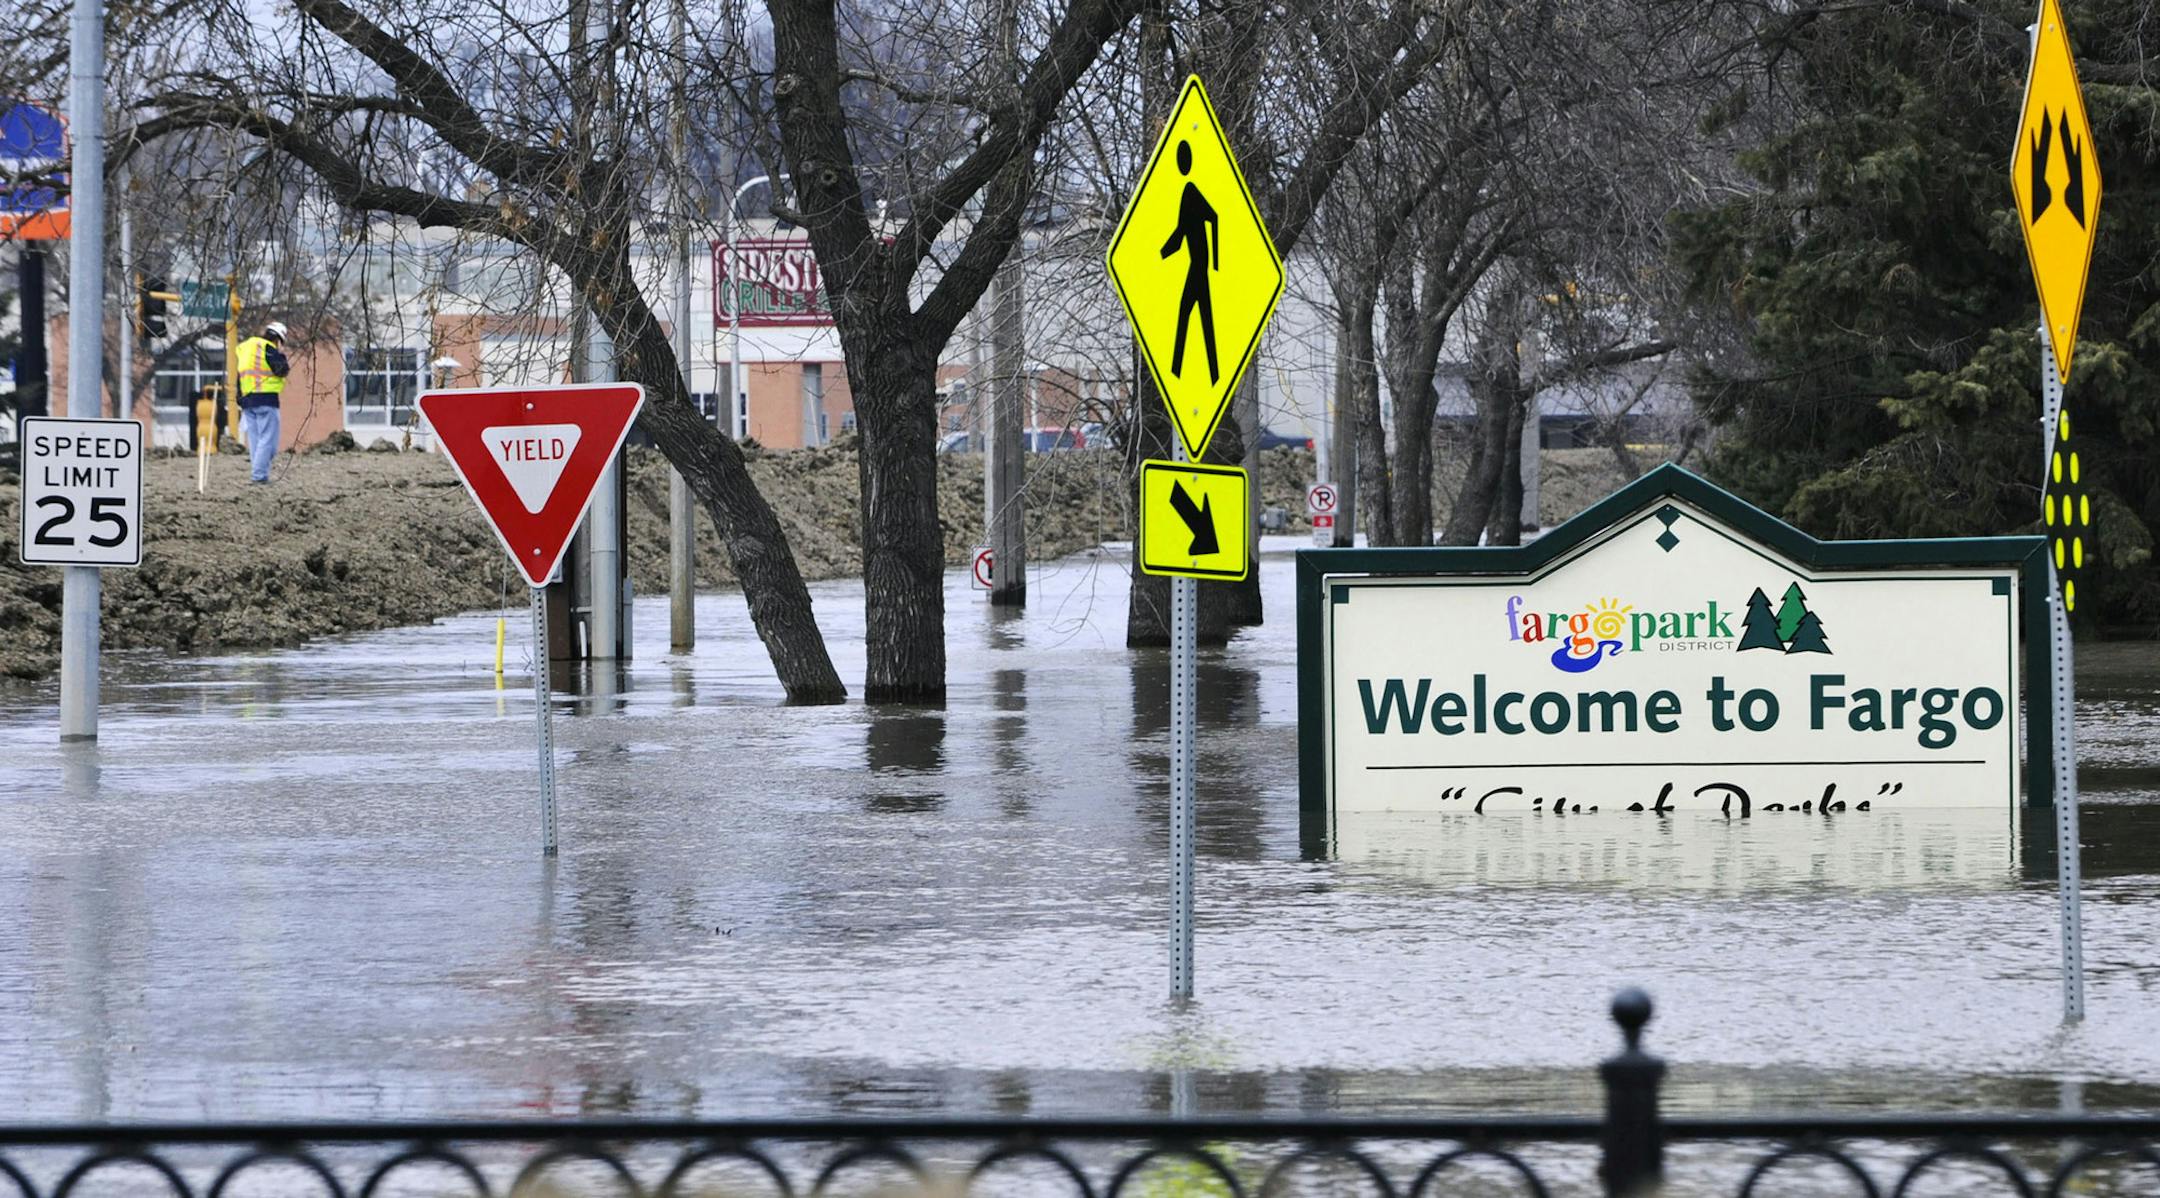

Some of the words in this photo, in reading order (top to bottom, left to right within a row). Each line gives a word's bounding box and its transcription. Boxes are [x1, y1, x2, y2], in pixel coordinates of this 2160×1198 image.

[34, 436, 131, 458] SPEED
[500, 438, 564, 461] YIELD
[45, 466, 119, 488] LIMIT
[34, 495, 128, 548] 25
[1629, 600, 1735, 652] park
[1659, 640, 1735, 652] DISTRICT
[1357, 673, 1682, 737] Welcome
[1707, 675, 1780, 733] to
[1809, 673, 2004, 750] Fargo
